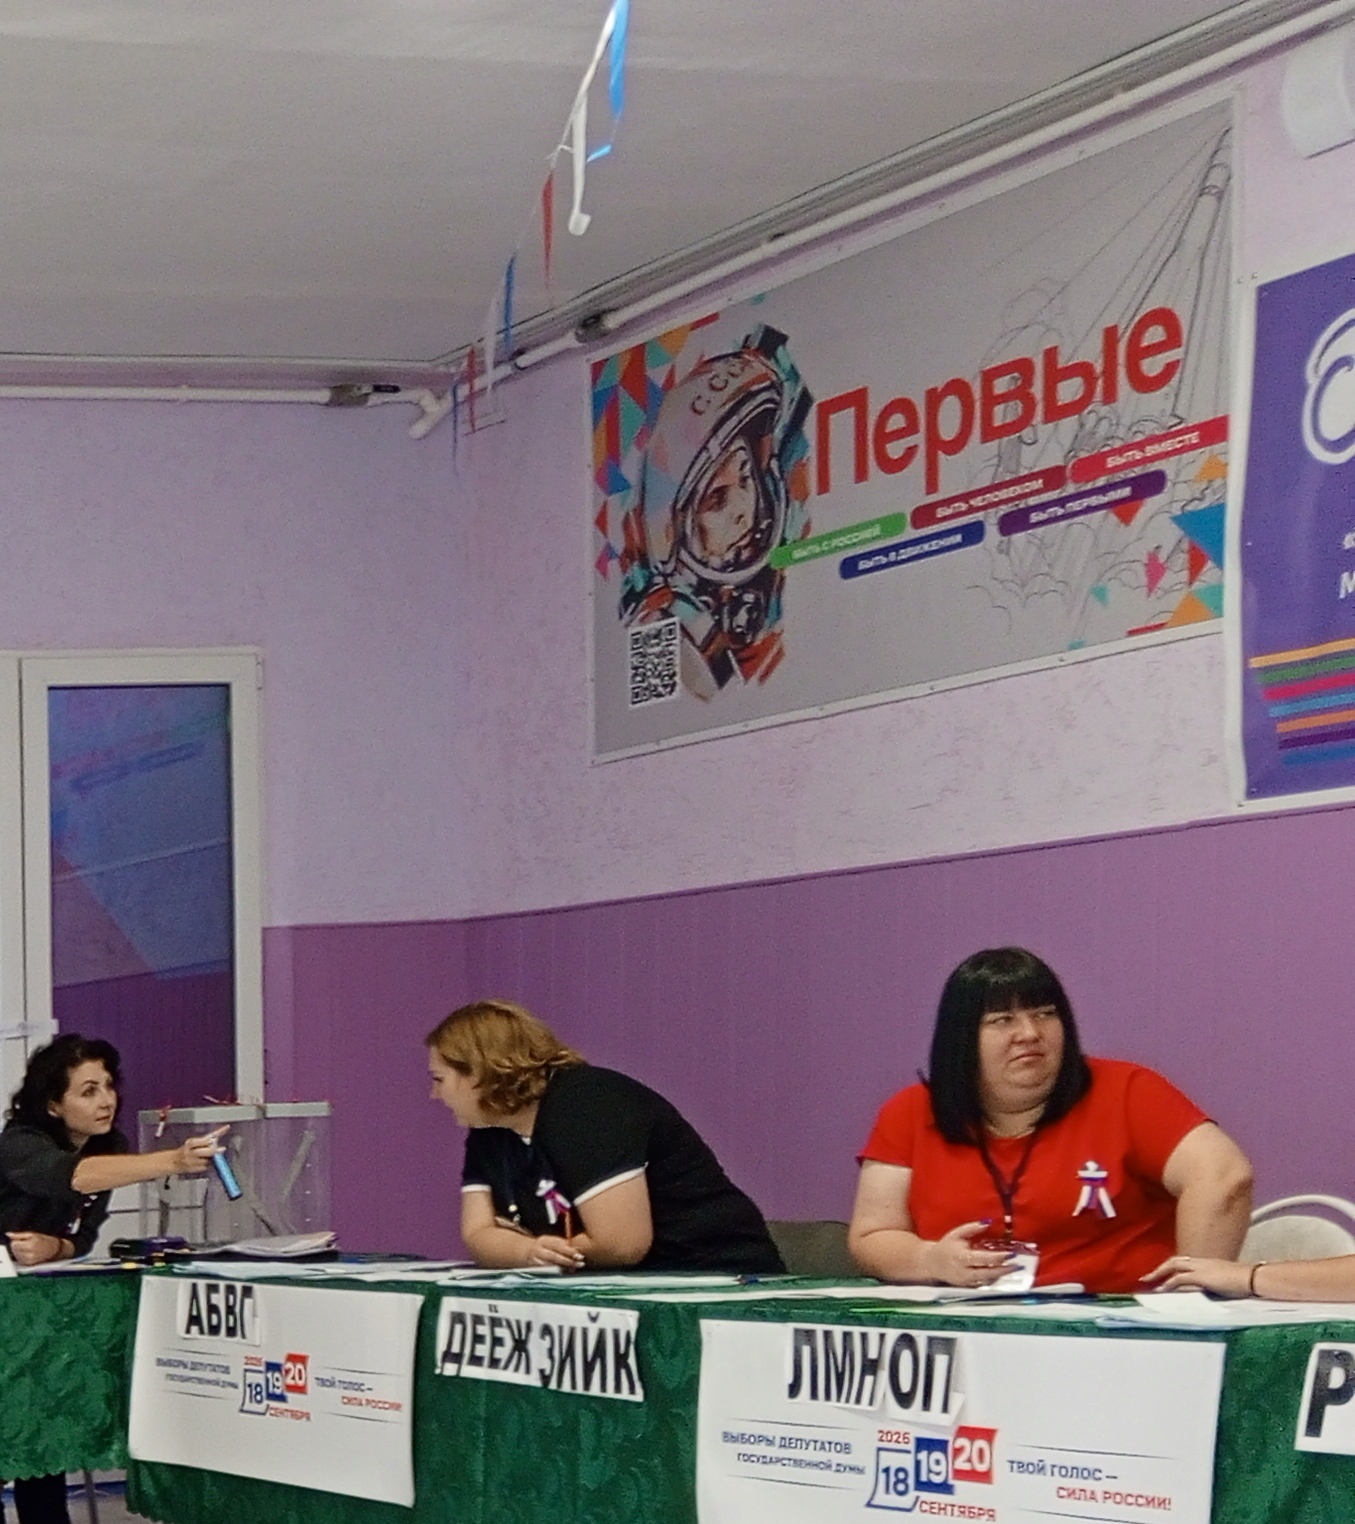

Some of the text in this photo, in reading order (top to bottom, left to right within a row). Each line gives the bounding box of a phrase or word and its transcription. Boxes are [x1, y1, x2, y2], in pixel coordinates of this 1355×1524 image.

[816, 306, 1184, 495] Первые
[788, 1328, 959, 1413] ЛМНОП
[247, 1363, 306, 1404] 18 19 20
[722, 1431, 852, 1454] ВЫБОРЫ ДЕПУТАТОВ
[877, 1430, 911, 1444] 2026
[737, 1452, 866, 1476] ГОСУДАРСТВЕННОЙ ДУМЫ
[881, 1437, 992, 1497] 18 19 20
[1007, 1459, 1046, 1476] ТВОЙ
[1050, 1464, 1102, 1481] ГОЛОС
[1056, 1486, 1172, 1511] СИЛА РОССИИ!
[919, 1500, 997, 1522] СЕНТЯБРЯ
